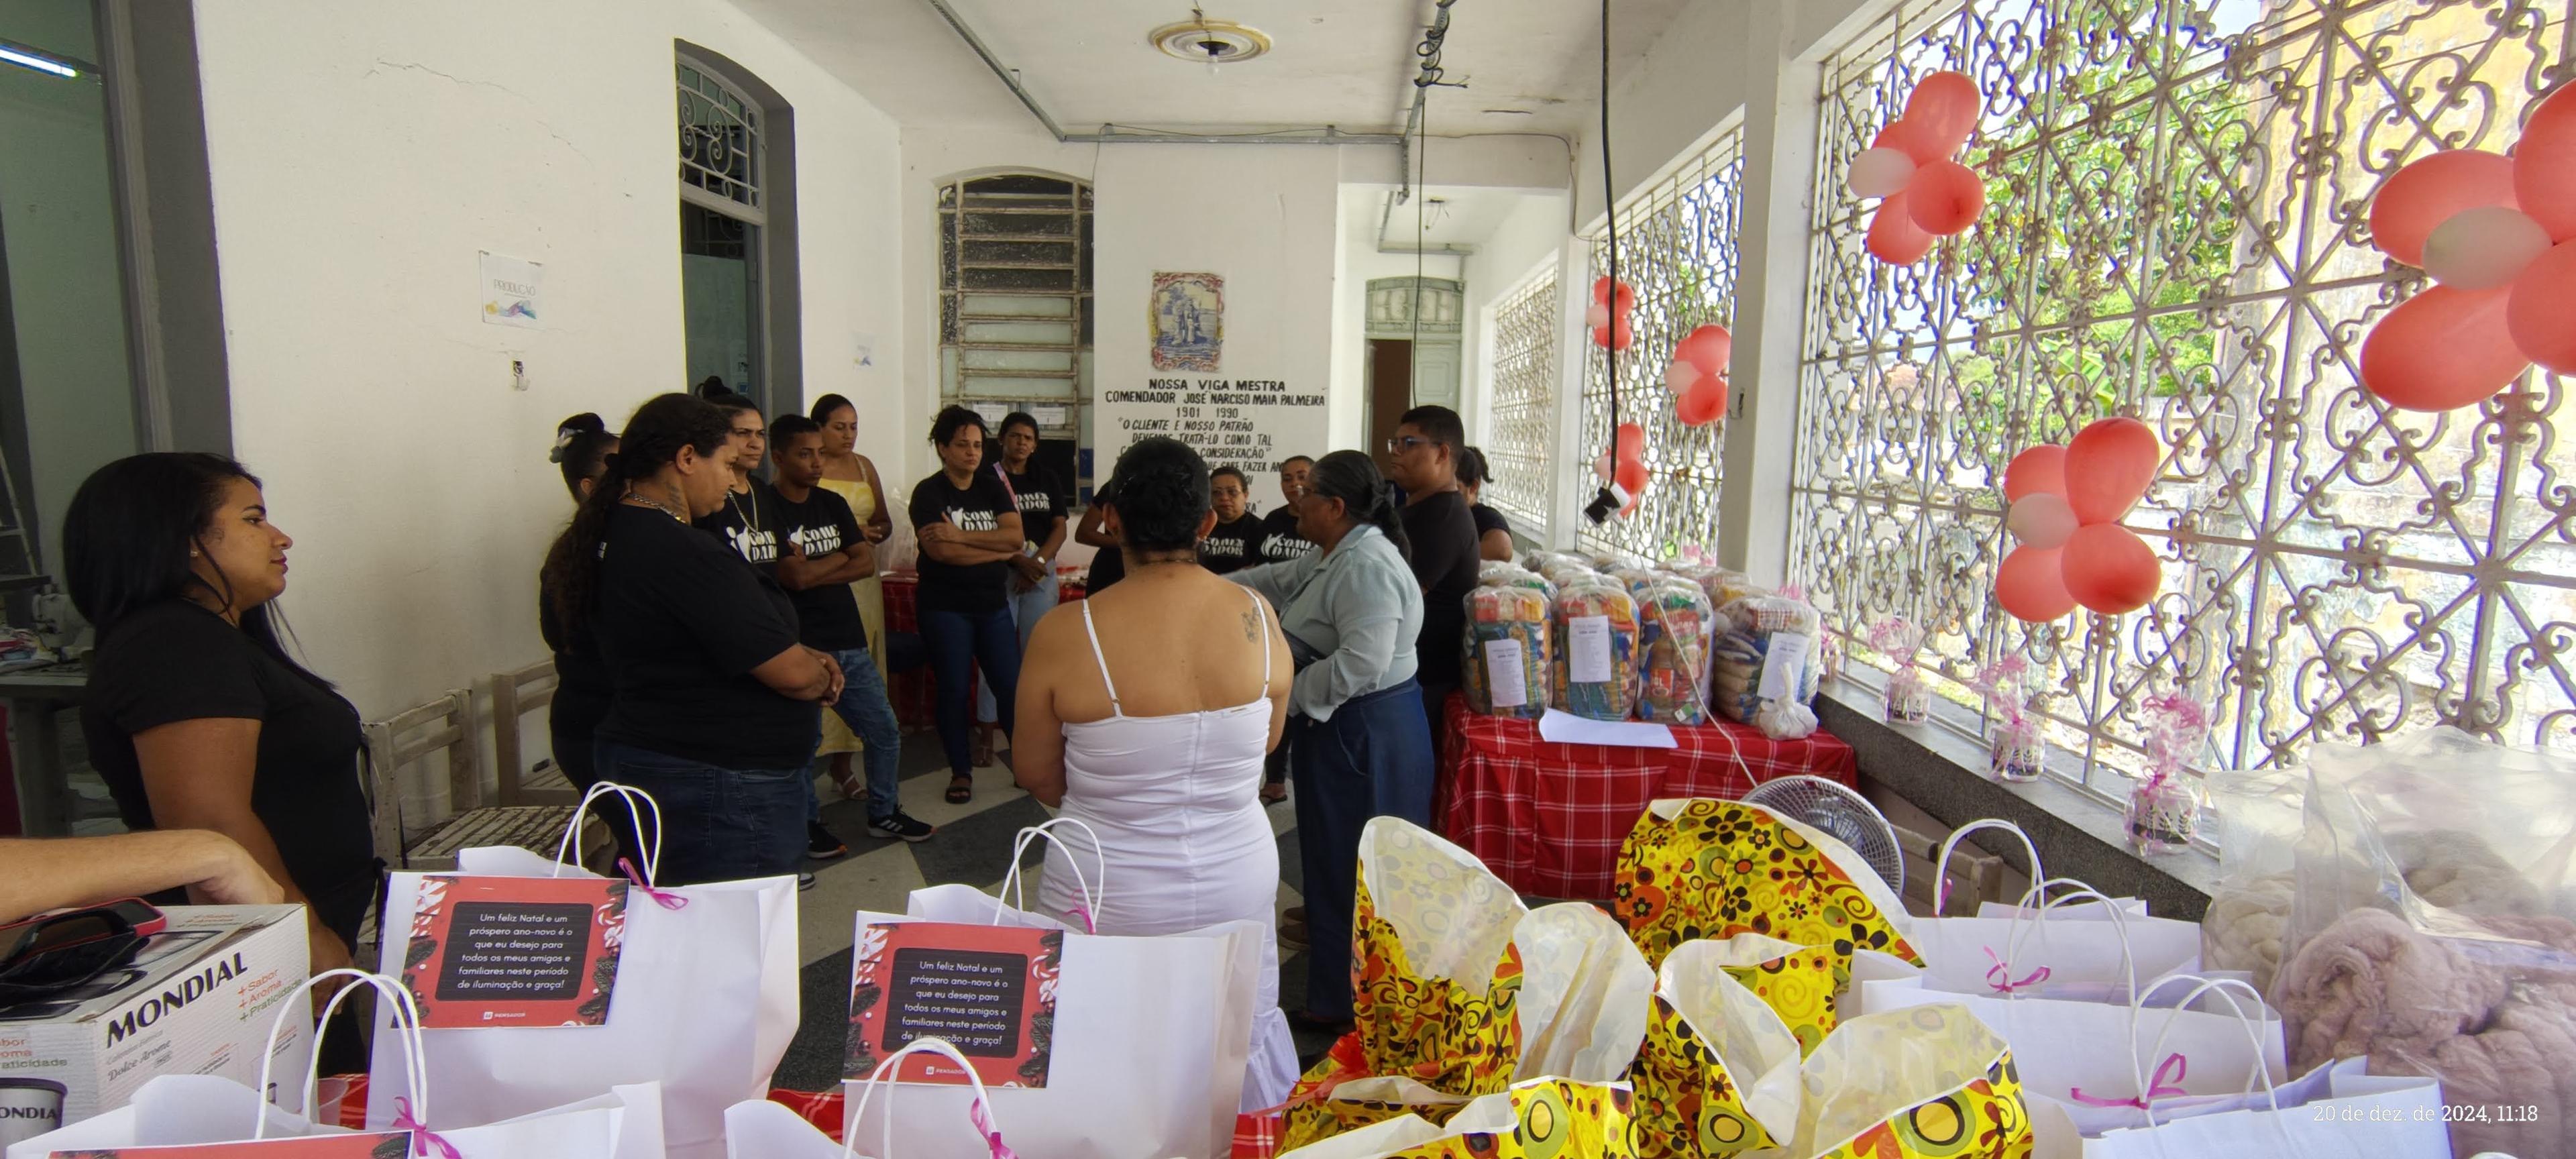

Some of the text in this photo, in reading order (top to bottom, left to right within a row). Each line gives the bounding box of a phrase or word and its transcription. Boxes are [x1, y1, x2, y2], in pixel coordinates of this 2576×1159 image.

[1149, 379, 1285, 392] NOSSA VIGA MESTRA
[1106, 390, 1175, 403] COMENDADOR
[1210, 393, 1250, 404] NARCISO
[1252, 394, 1277, 405] MAIA
[1280, 394, 1325, 406] PALMEIRA
[1176, 407, 1238, 418] 1901 1990
[1132, 419, 1169, 431] CLIENTE
[1184, 421, 1215, 431] NOSSO
[1219, 418, 1254, 431] PATRÃO
[1224, 434, 1251, 445] COMO
[1258, 433, 1273, 446] TAL
[1242, 462, 1267, 472] FAZER
[480, 914, 495, 922] Um
[498, 913, 517, 922] feliz
[519, 914, 544, 922] Natal
[469, 927, 511, 936] próspero
[558, 928, 564, 936] é
[474, 941, 492, 950] que
[509, 940, 539, 950] desejo
[541, 942, 564, 950] para
[462, 953, 488, 962] todos
[530, 954, 562, 964] amigos
[458, 966, 504, 975] familiares
[533, 967, 569, 977] período
[920, 961, 934, 970] Um
[936, 961, 954, 971] feliz
[956, 963, 979, 972] Natal
[458, 980, 470, 988] de
[472, 980, 524, 991] iluminação
[534, 979, 565, 991] graça!
[910, 975, 949, 985] próspero
[951, 978, 992, 987] ano-novo
[994, 979, 1000, 987] é
[107, 952, 248, 1048] MONDIAL
[916, 991, 932, 999] que
[948, 990, 976, 1001] desejo
[978, 994, 999, 1002] para
[904, 1003, 928, 1012] todos
[967, 1007, 999, 1017] amigos
[902, 1016, 1006, 1031] familiares neste período
[901, 1030, 913, 1040] de
[972, 1036, 1002, 1047] graça!
